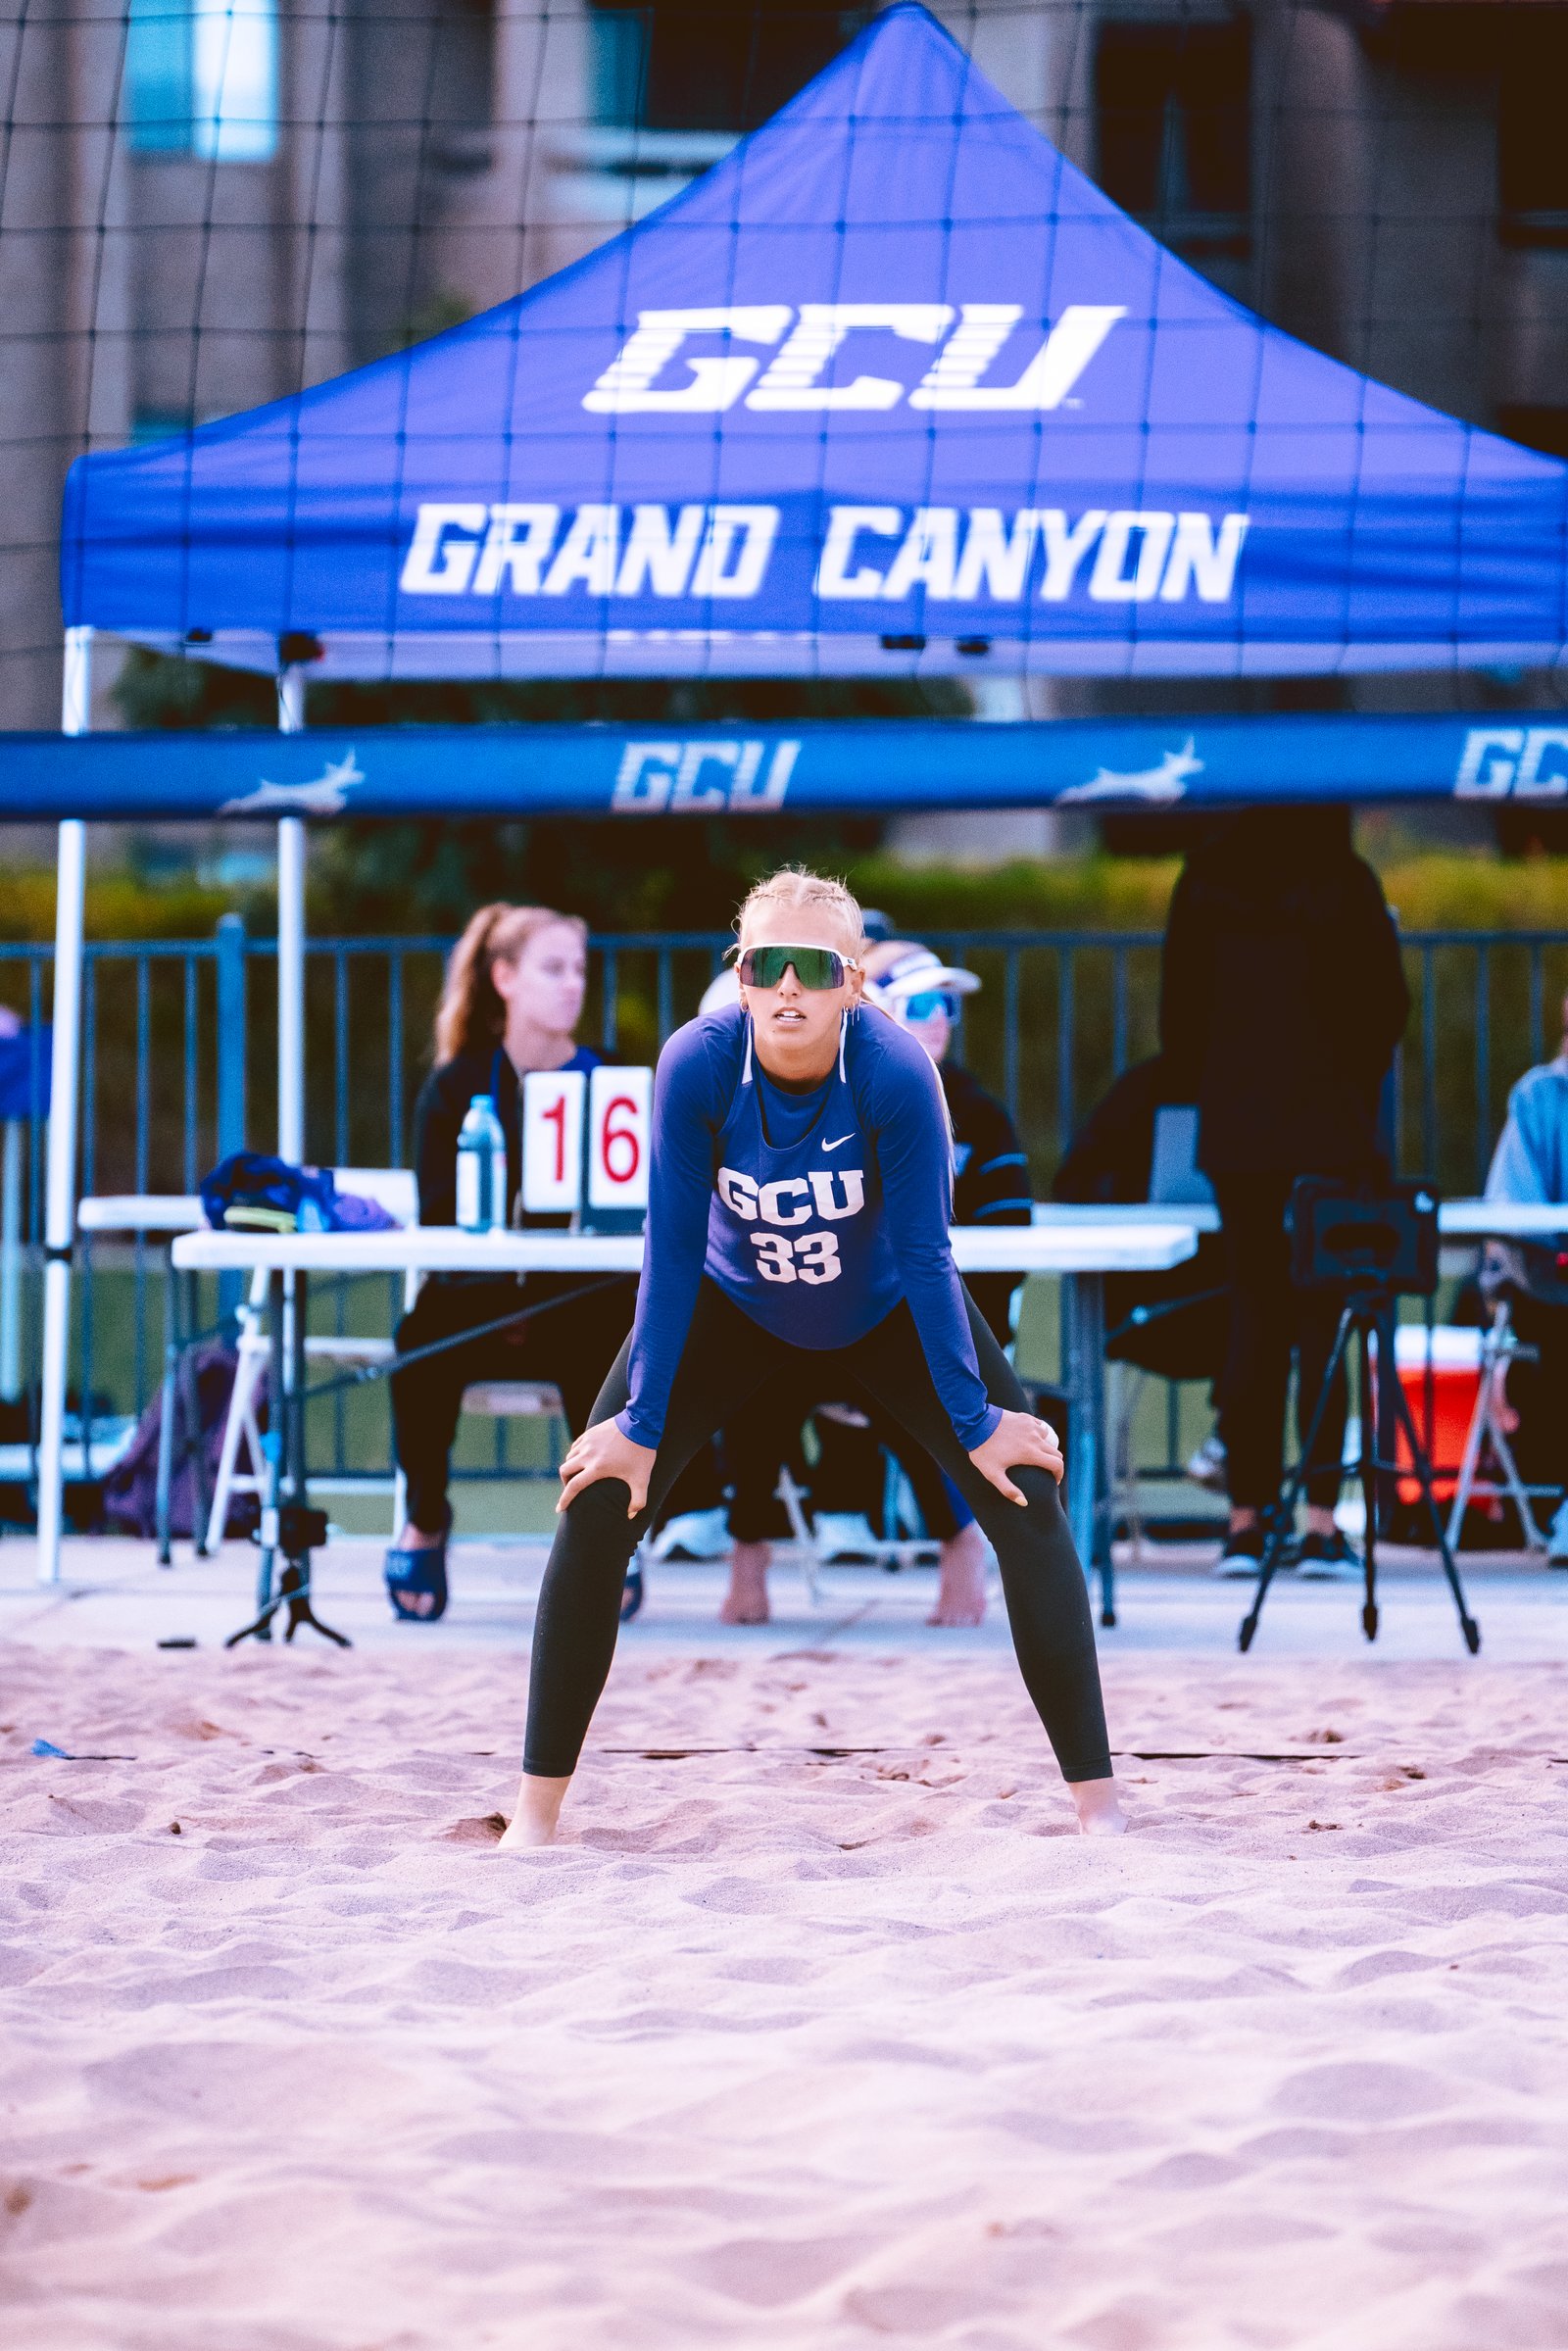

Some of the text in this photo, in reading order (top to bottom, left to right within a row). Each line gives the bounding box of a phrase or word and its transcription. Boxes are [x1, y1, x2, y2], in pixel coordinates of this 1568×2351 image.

[581, 304, 1129, 413] GCU
[400, 503, 1250, 603] GRAND CANYON
[611, 740, 801, 813] GCU
[717, 1166, 864, 1226] GCU
[750, 1231, 843, 1285] 33
